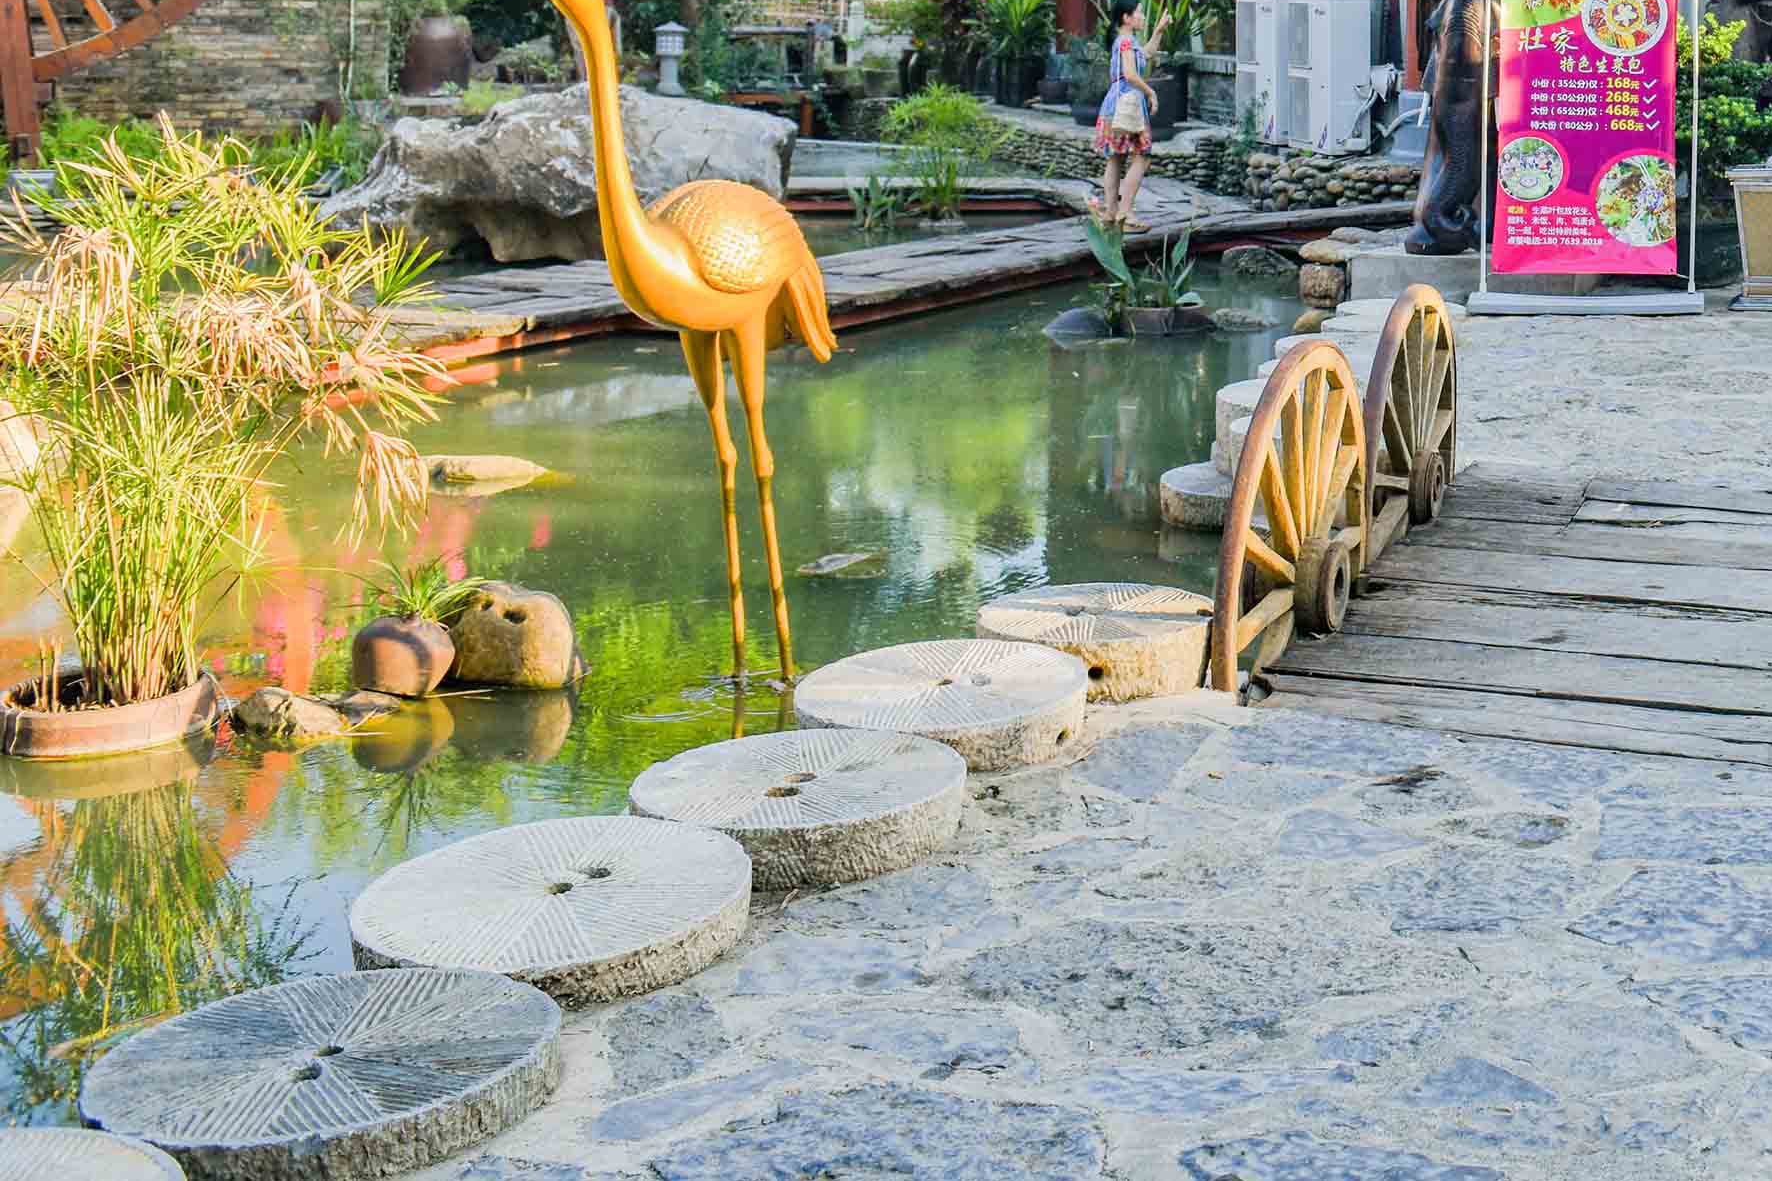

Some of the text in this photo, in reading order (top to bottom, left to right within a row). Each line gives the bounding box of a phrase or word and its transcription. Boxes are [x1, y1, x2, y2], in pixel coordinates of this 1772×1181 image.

[1559, 55, 1645, 75] 特色生菜包
